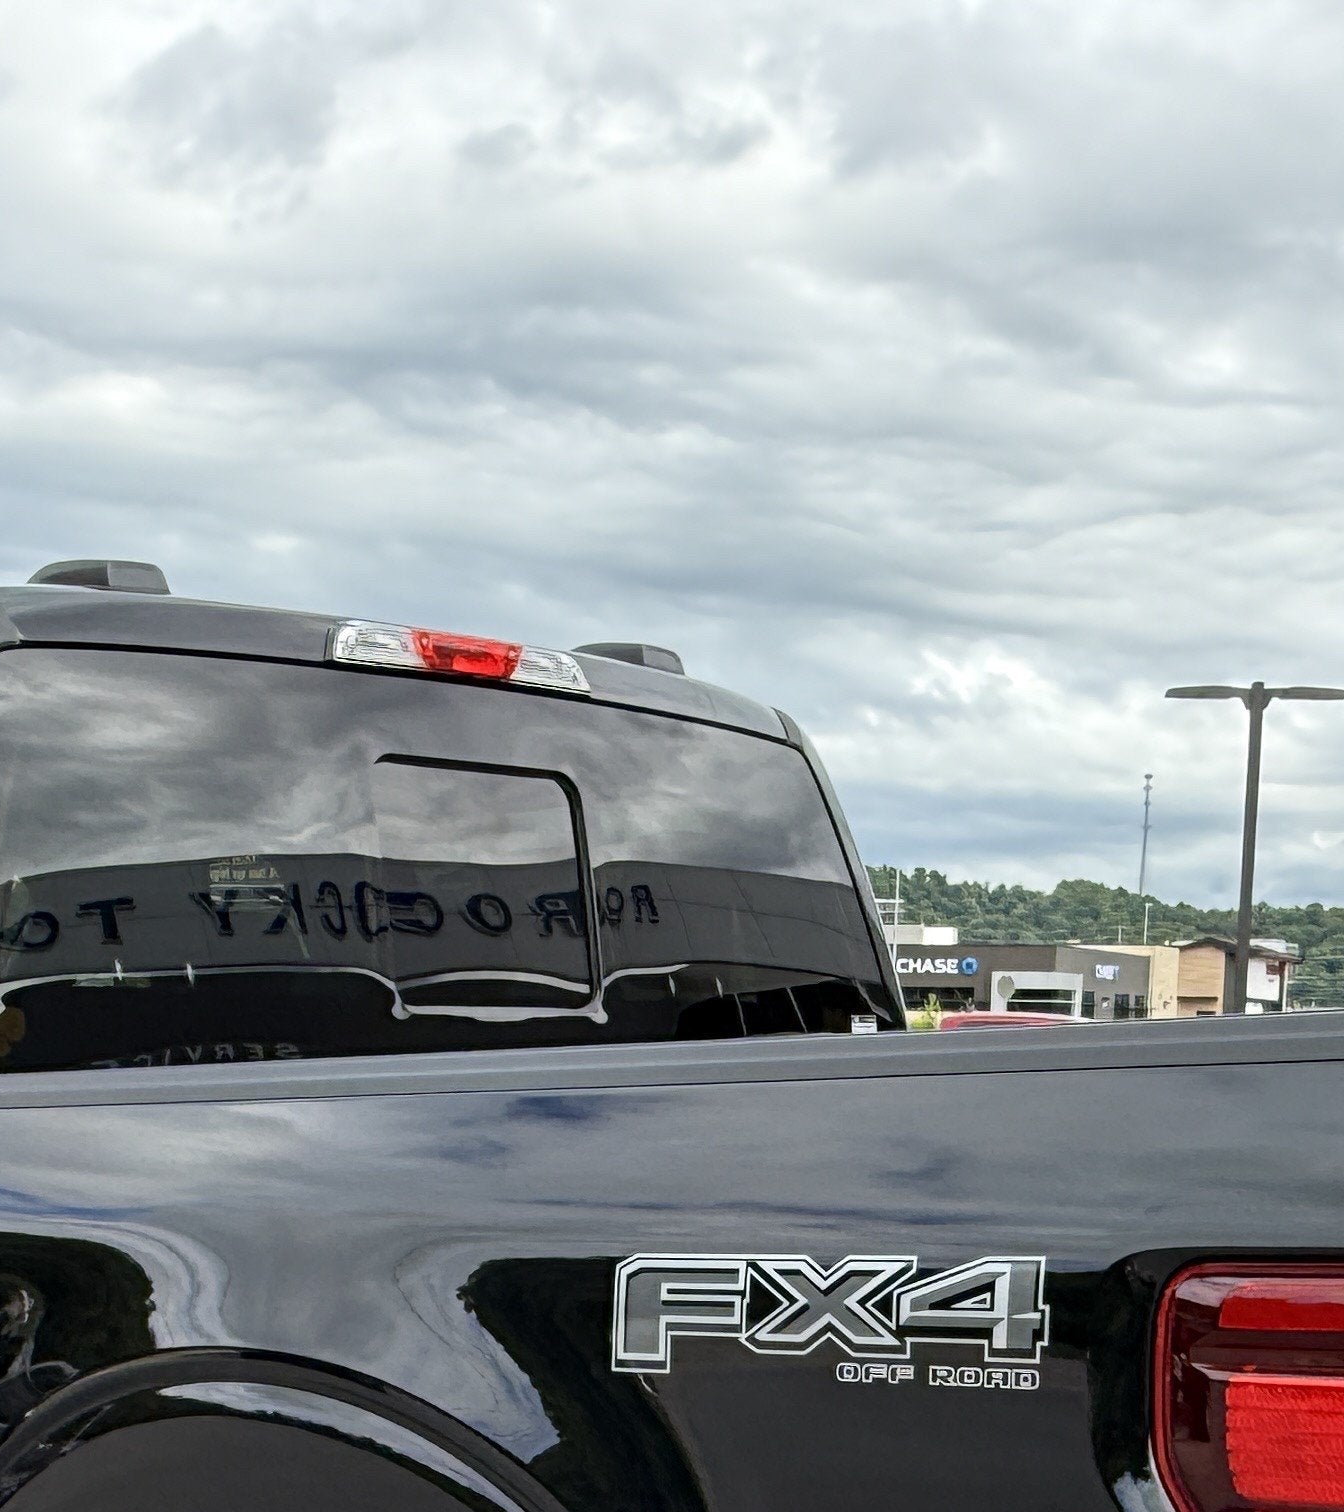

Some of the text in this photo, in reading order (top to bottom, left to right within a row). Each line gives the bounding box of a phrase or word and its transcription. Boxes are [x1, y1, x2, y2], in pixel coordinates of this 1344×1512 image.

[896, 958, 958, 973] CHASE
[612, 1253, 1050, 1374] FX4
[836, 1362, 1040, 1390] OFF ROAD
